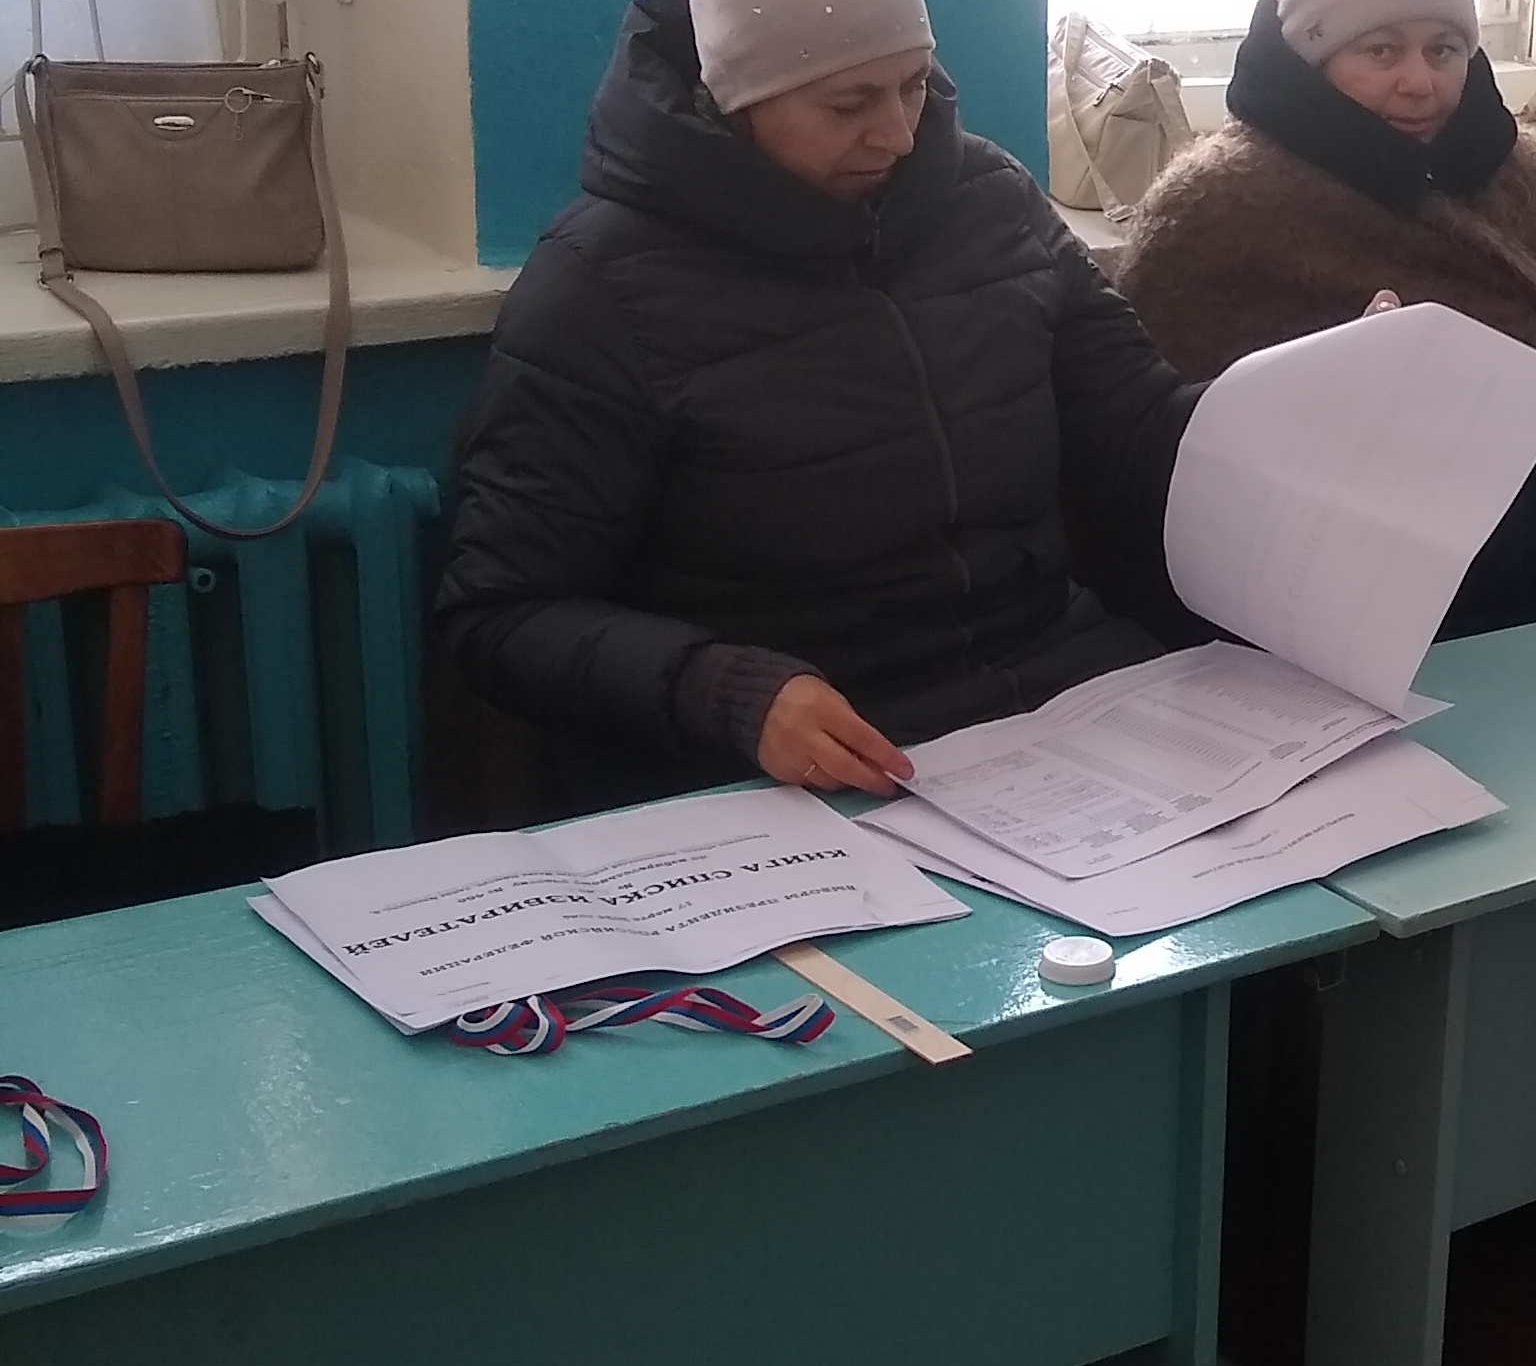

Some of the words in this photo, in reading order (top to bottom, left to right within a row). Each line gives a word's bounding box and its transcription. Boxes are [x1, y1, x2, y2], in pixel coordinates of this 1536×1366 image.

[740, 848, 850, 873] КНИГА
[598, 870, 732, 906] СПИСКА
[784, 884, 857, 901] ВЫБОРЫ
[342, 895, 592, 956] ИЗБИРАТЕЛЕЙ
[665, 898, 780, 932] ПРЕЗИДЕНТА
[419, 939, 534, 976] ФЕДЕРАЦИИ
